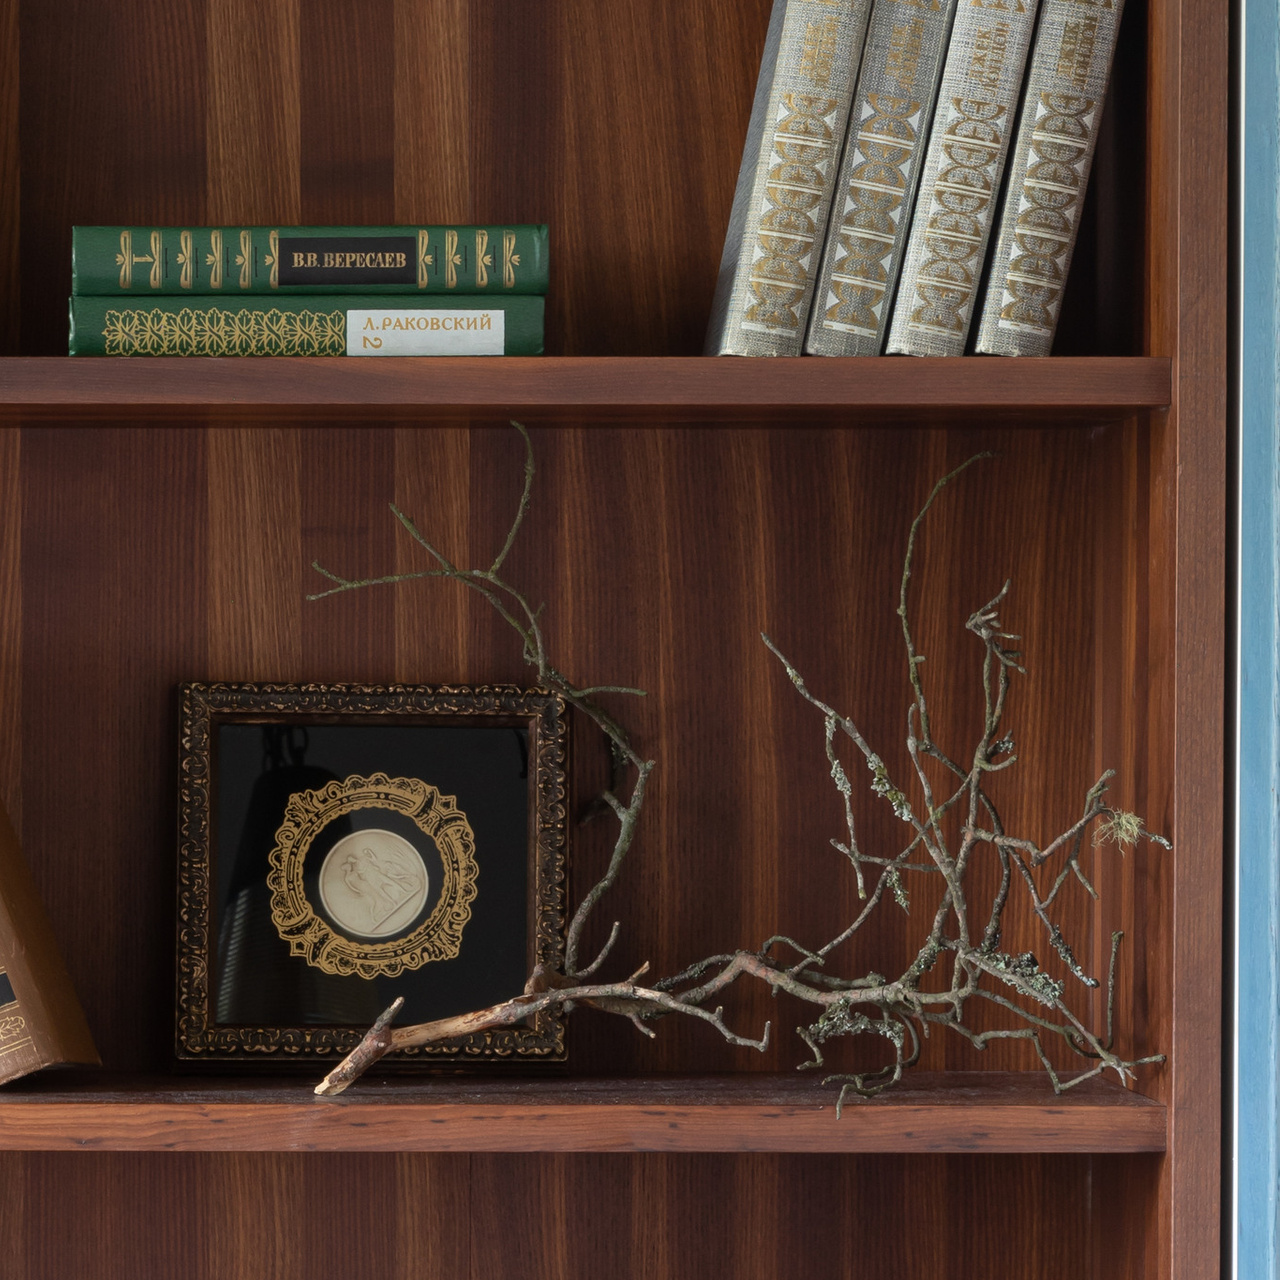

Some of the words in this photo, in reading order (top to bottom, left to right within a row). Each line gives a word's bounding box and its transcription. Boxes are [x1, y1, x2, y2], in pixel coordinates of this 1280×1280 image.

[969, 25, 991, 83] ДЖЕК
[1058, 20, 1080, 78] ДЖЕК
[362, 335, 383, 349] 2
